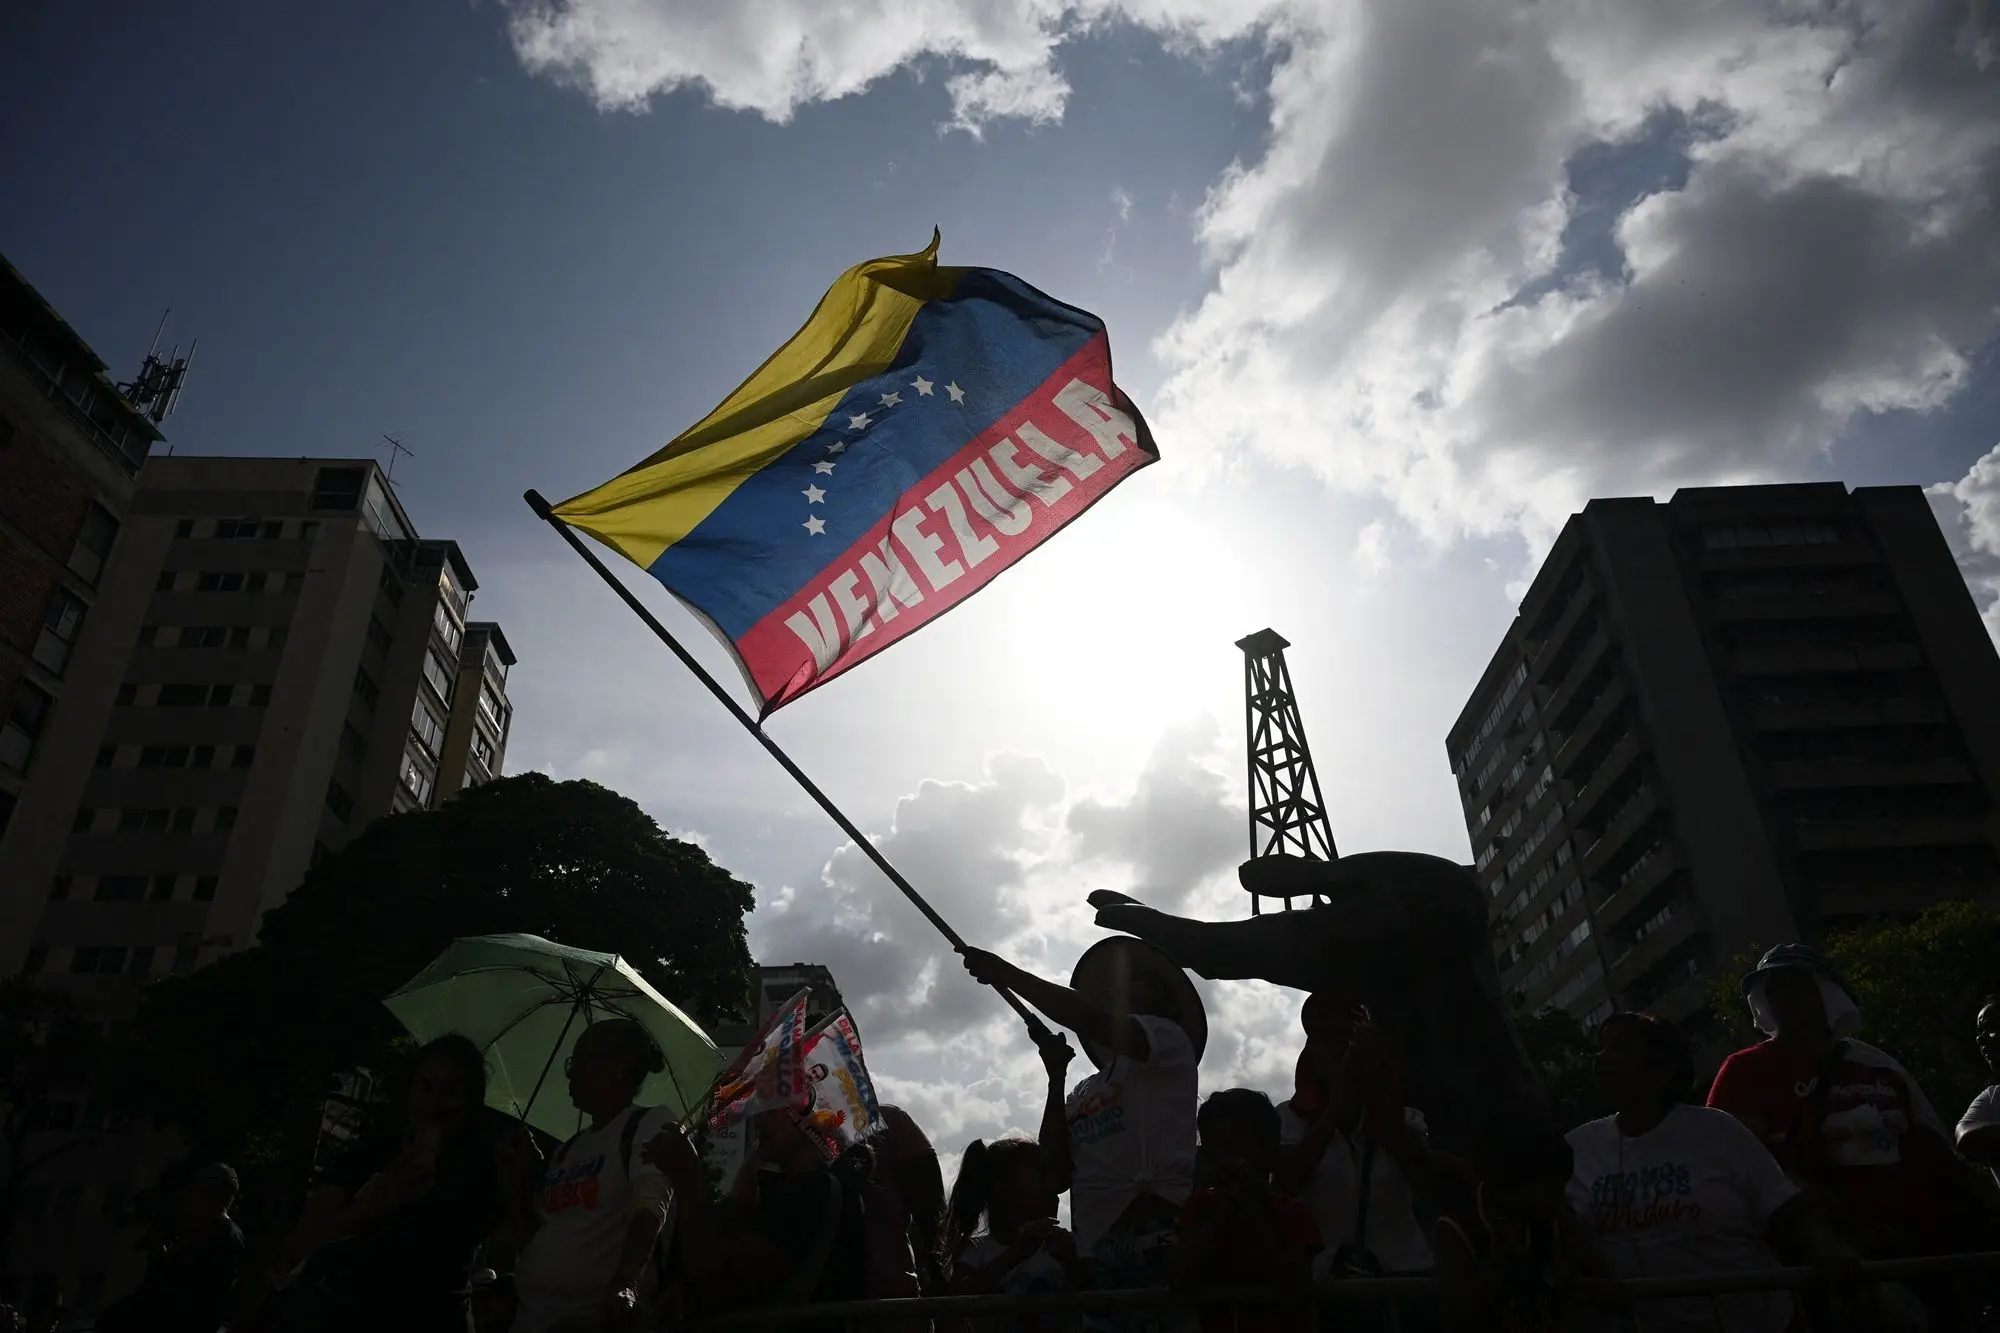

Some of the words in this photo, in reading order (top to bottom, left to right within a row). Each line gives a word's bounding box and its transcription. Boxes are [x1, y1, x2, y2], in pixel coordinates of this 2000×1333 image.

[785, 377, 1138, 675] VENEZUELA
[839, 1018, 853, 1036] DE
[848, 1035, 860, 1054] LA
